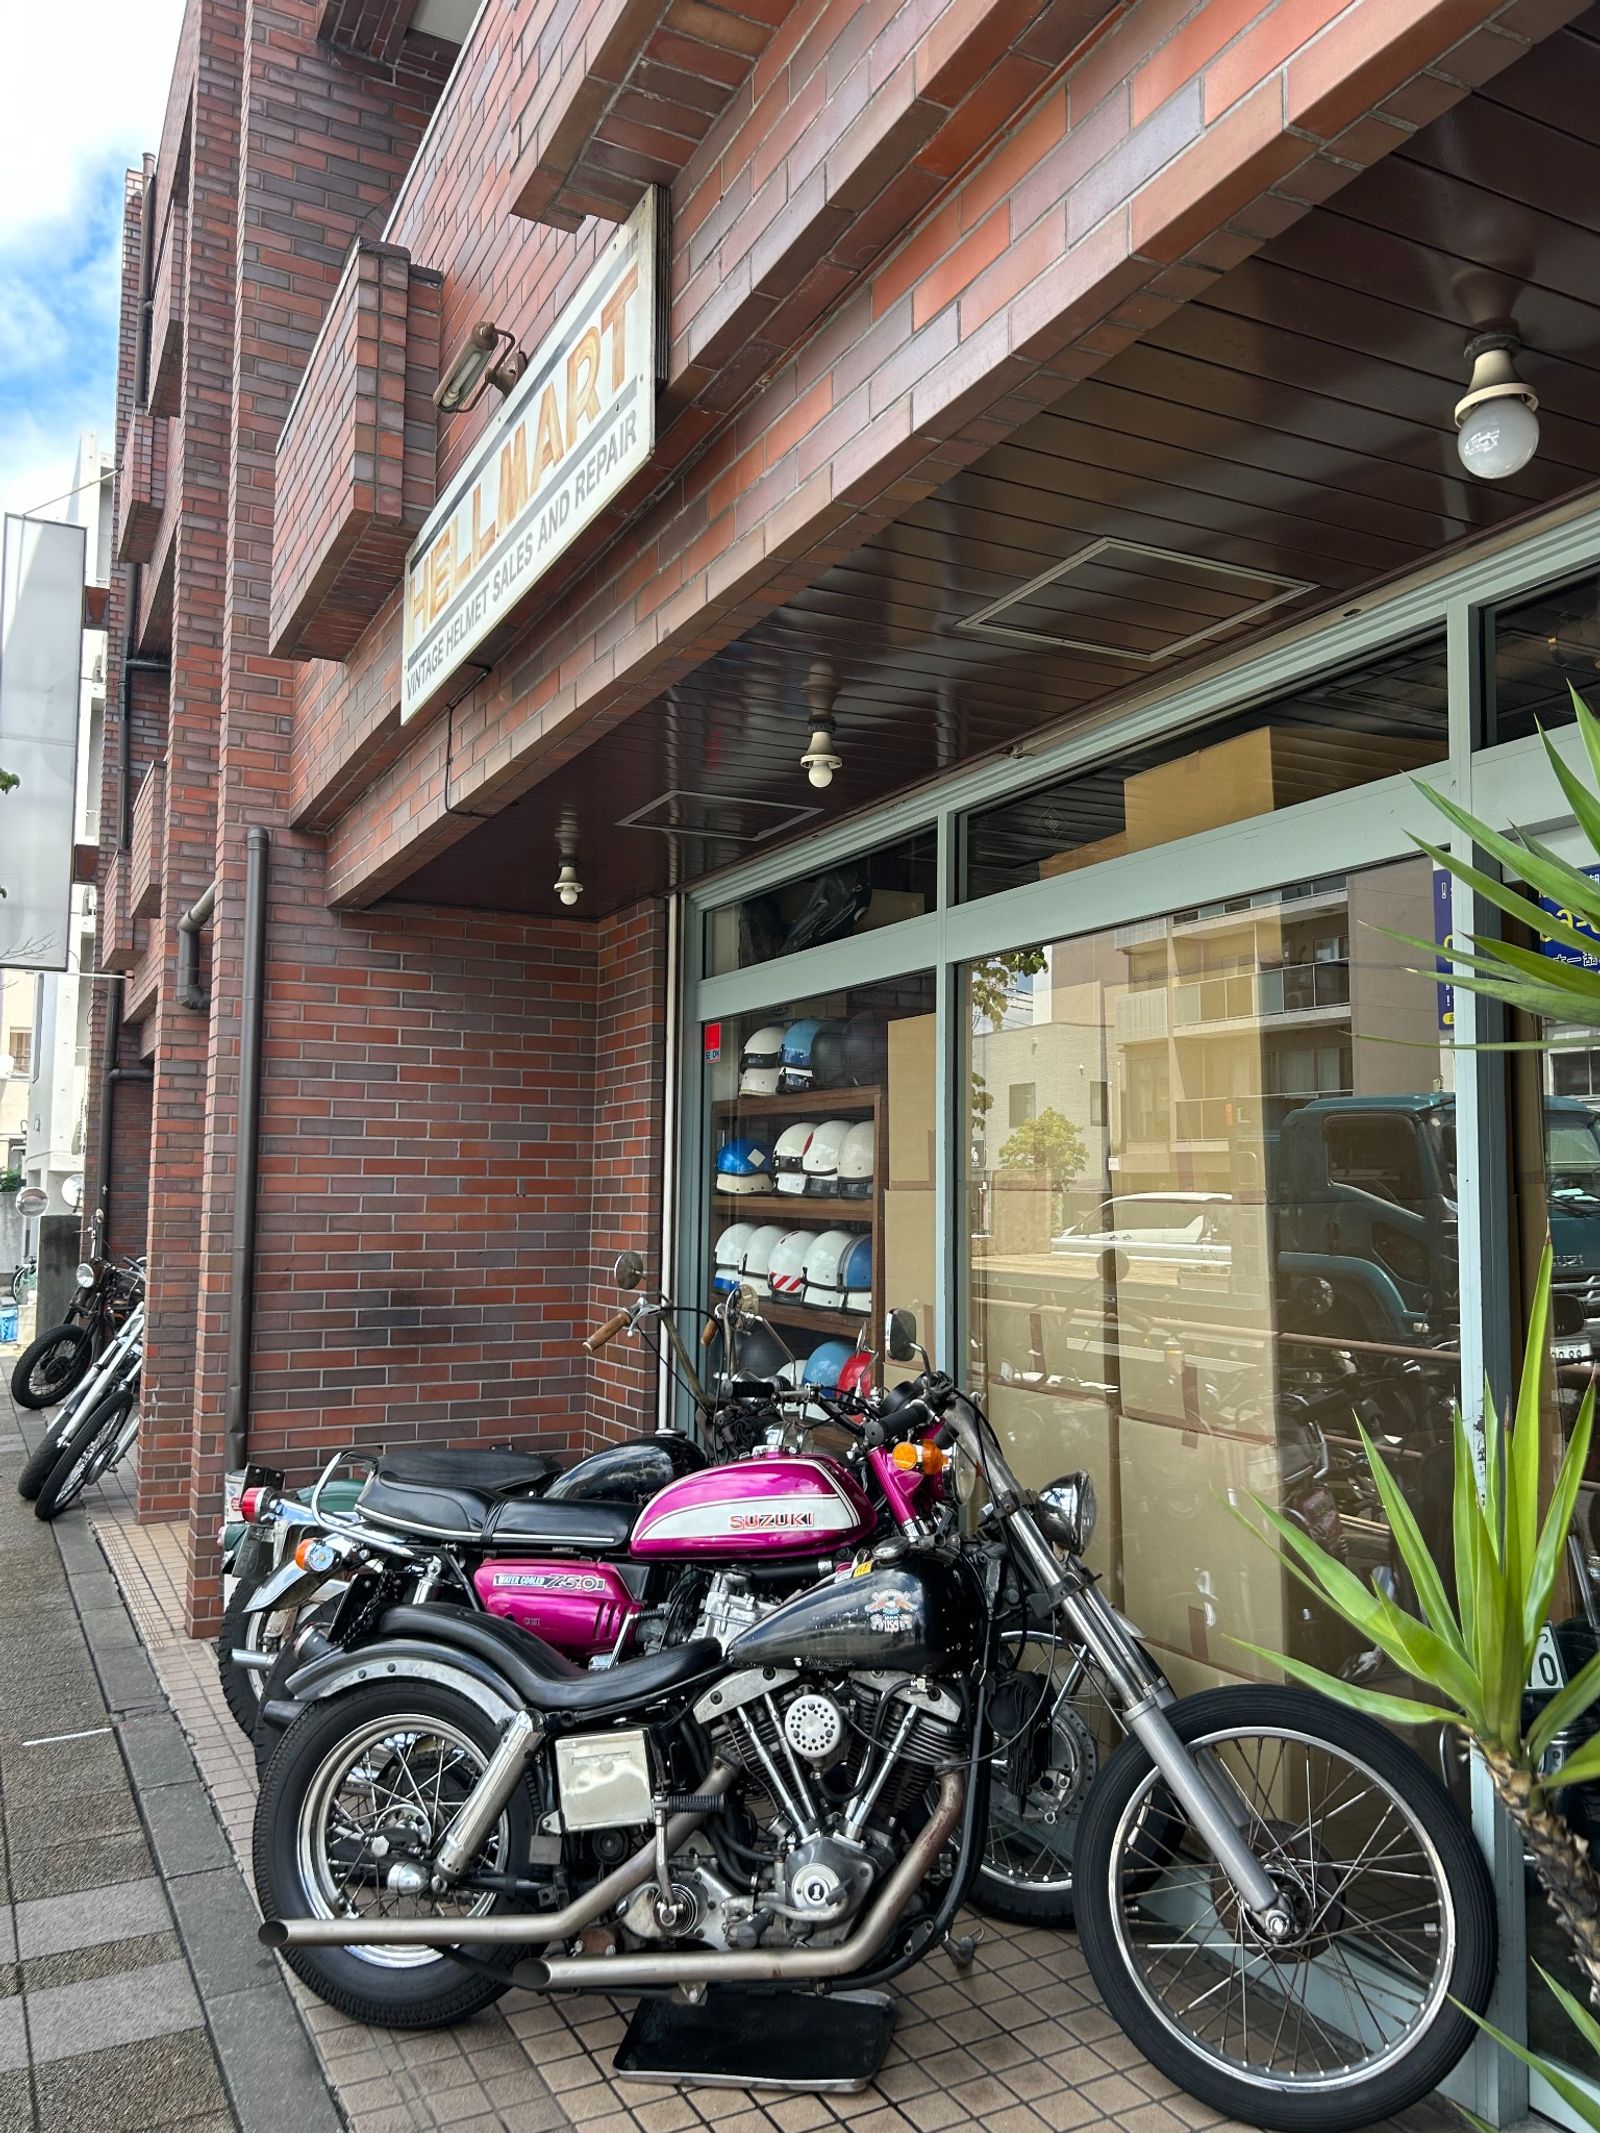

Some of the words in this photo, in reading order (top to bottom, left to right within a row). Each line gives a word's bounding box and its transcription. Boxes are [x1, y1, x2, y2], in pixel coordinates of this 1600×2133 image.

[406, 638, 443, 701] VINTAGE
[446, 582, 490, 656] HELMET
[492, 532, 533, 602] SALES
[538, 489, 570, 552] AND
[575, 409, 637, 510] REPAIR
[729, 1512, 814, 1530] SUZUKI
